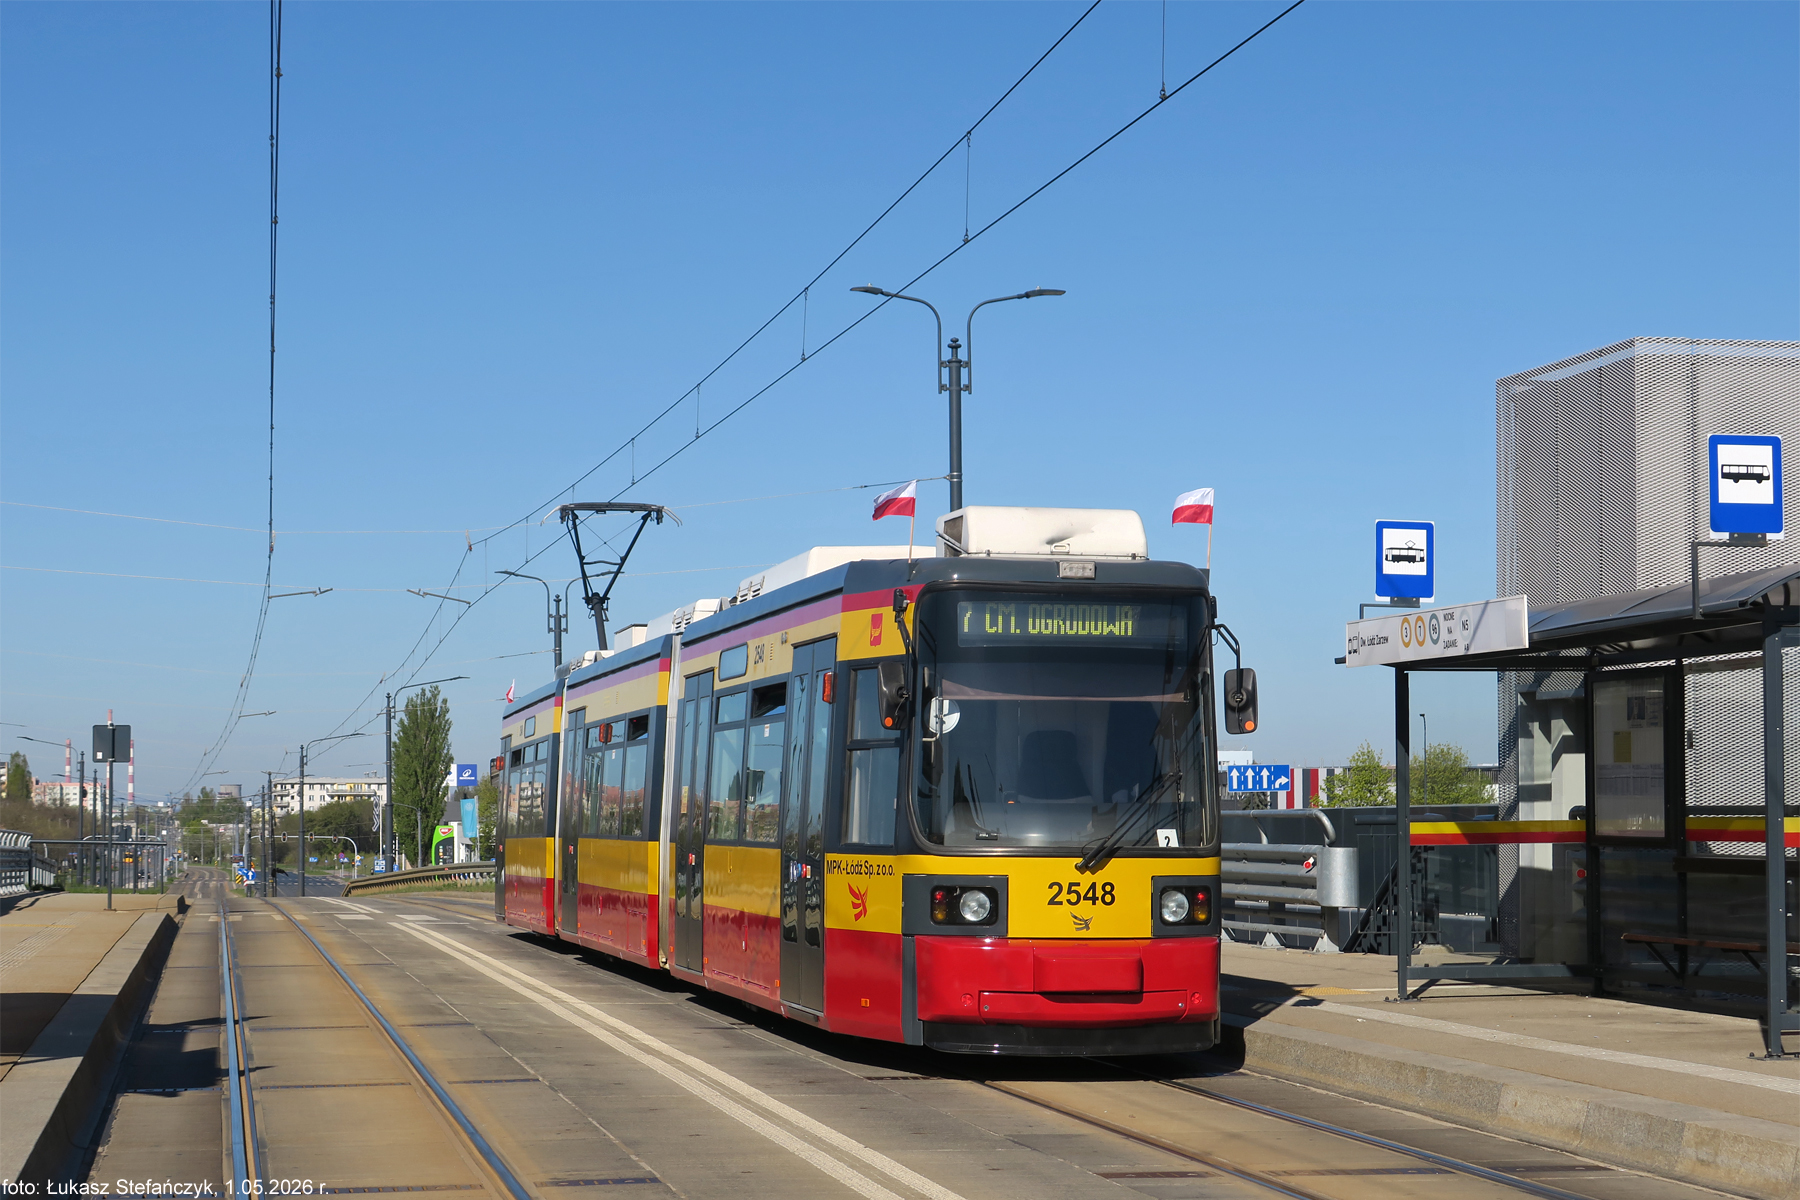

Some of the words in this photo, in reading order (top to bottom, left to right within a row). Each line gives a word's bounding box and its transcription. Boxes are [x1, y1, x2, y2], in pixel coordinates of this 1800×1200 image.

[960, 602, 973, 633] 7
[985, 602, 1021, 634] CM.
[1028, 603, 1133, 636] OGRODOWA
[1461, 619, 1469, 631] N5
[1404, 626, 1409, 638] 3
[1418, 625, 1422, 637] 7
[1431, 623, 1438, 635] 96
[1164, 835, 1171, 848] 2
[826, 859, 863, 875] MPK-Łódź
[863, 859, 876, 879] Sp.
[1047, 881, 1116, 906] 2548
